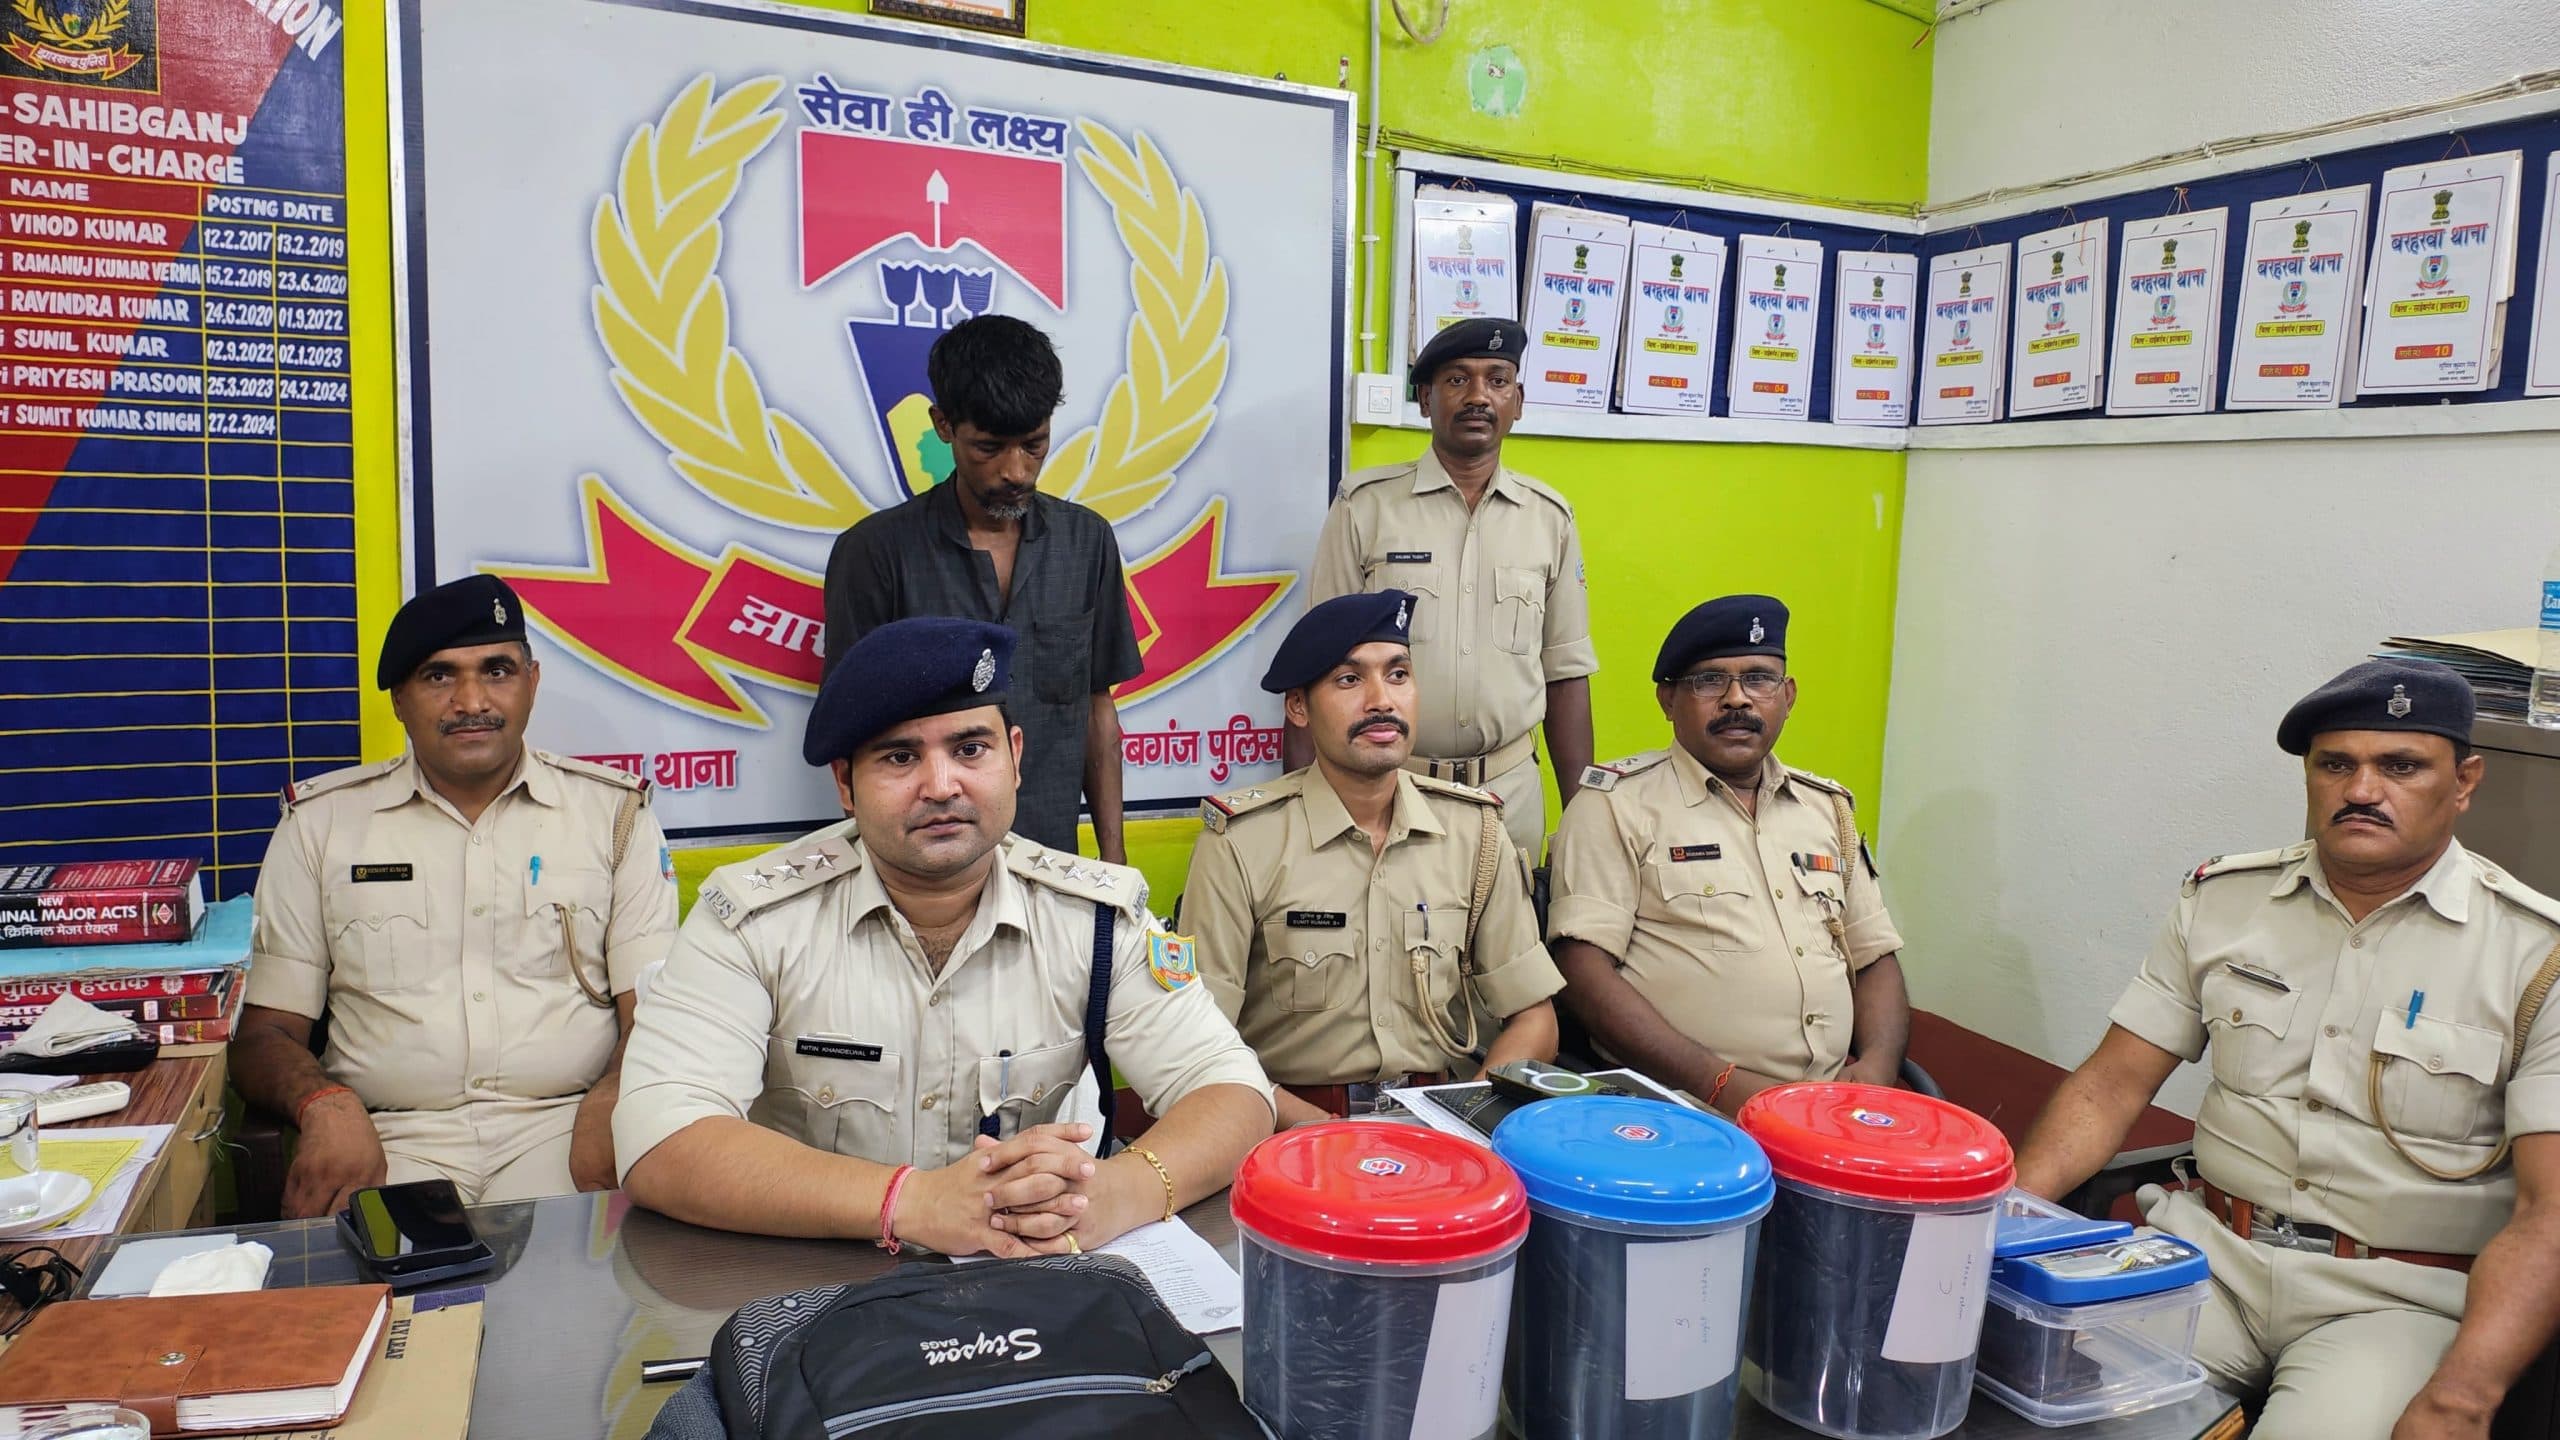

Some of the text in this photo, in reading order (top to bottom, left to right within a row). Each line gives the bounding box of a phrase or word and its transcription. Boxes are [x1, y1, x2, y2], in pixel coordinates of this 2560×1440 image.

[798, 75, 1067, 154] सेवा ही लक्ष्य
[10, 178, 90, 201] NAME
[207, 194, 334, 222] POSTNG DATE
[10, 213, 79, 238] VINOD
[84, 218, 168, 246] KUMAR
[204, 228, 345, 259] 12.2.2017 13.2.2019
[2391, 223, 2489, 255] बरहरवा थाना
[12, 252, 93, 277] RAMANUJ
[95, 257, 150, 280] KUMAR
[151, 262, 202, 285] VERMA
[2309, 253, 2344, 274] थाना
[205, 265, 347, 295] 15.2.2019 23.6.2020
[11, 289, 114, 318] RAVINDRA
[119, 296, 190, 322] KUMAR
[205, 302, 273, 327] 24.6.2020
[14, 327, 79, 352] SUNIL
[86, 331, 170, 357] KUMAR
[207, 340, 343, 368] 02.9.2022 02.1.2023
[2435, 346, 2450, 357] 10
[13, 365, 105, 391] PRIYESH
[110, 371, 202, 394] PRASOON
[1569, 374, 1581, 383] 02
[2292, 366, 2306, 376] 09
[207, 376, 348, 403] 25.3.2023 24.2.2024
[15, 404, 72, 427] SUMIT
[76, 407, 144, 430] KUMAR
[143, 410, 201, 432] SINGH
[728, 594, 826, 659] झार
[1207, 714, 1284, 783] पुलिस
[654, 750, 738, 791] थाना
[0, 905, 138, 923] INAL MAJOR ACTS
[37, 897, 64, 907] NEW
[57, 923, 82, 936] मेजर
[821, 1048, 866, 1057] KHANDELWAL
[385, 1318, 411, 1360] FLY LEAF
[920, 1337, 960, 1351] BAGS
